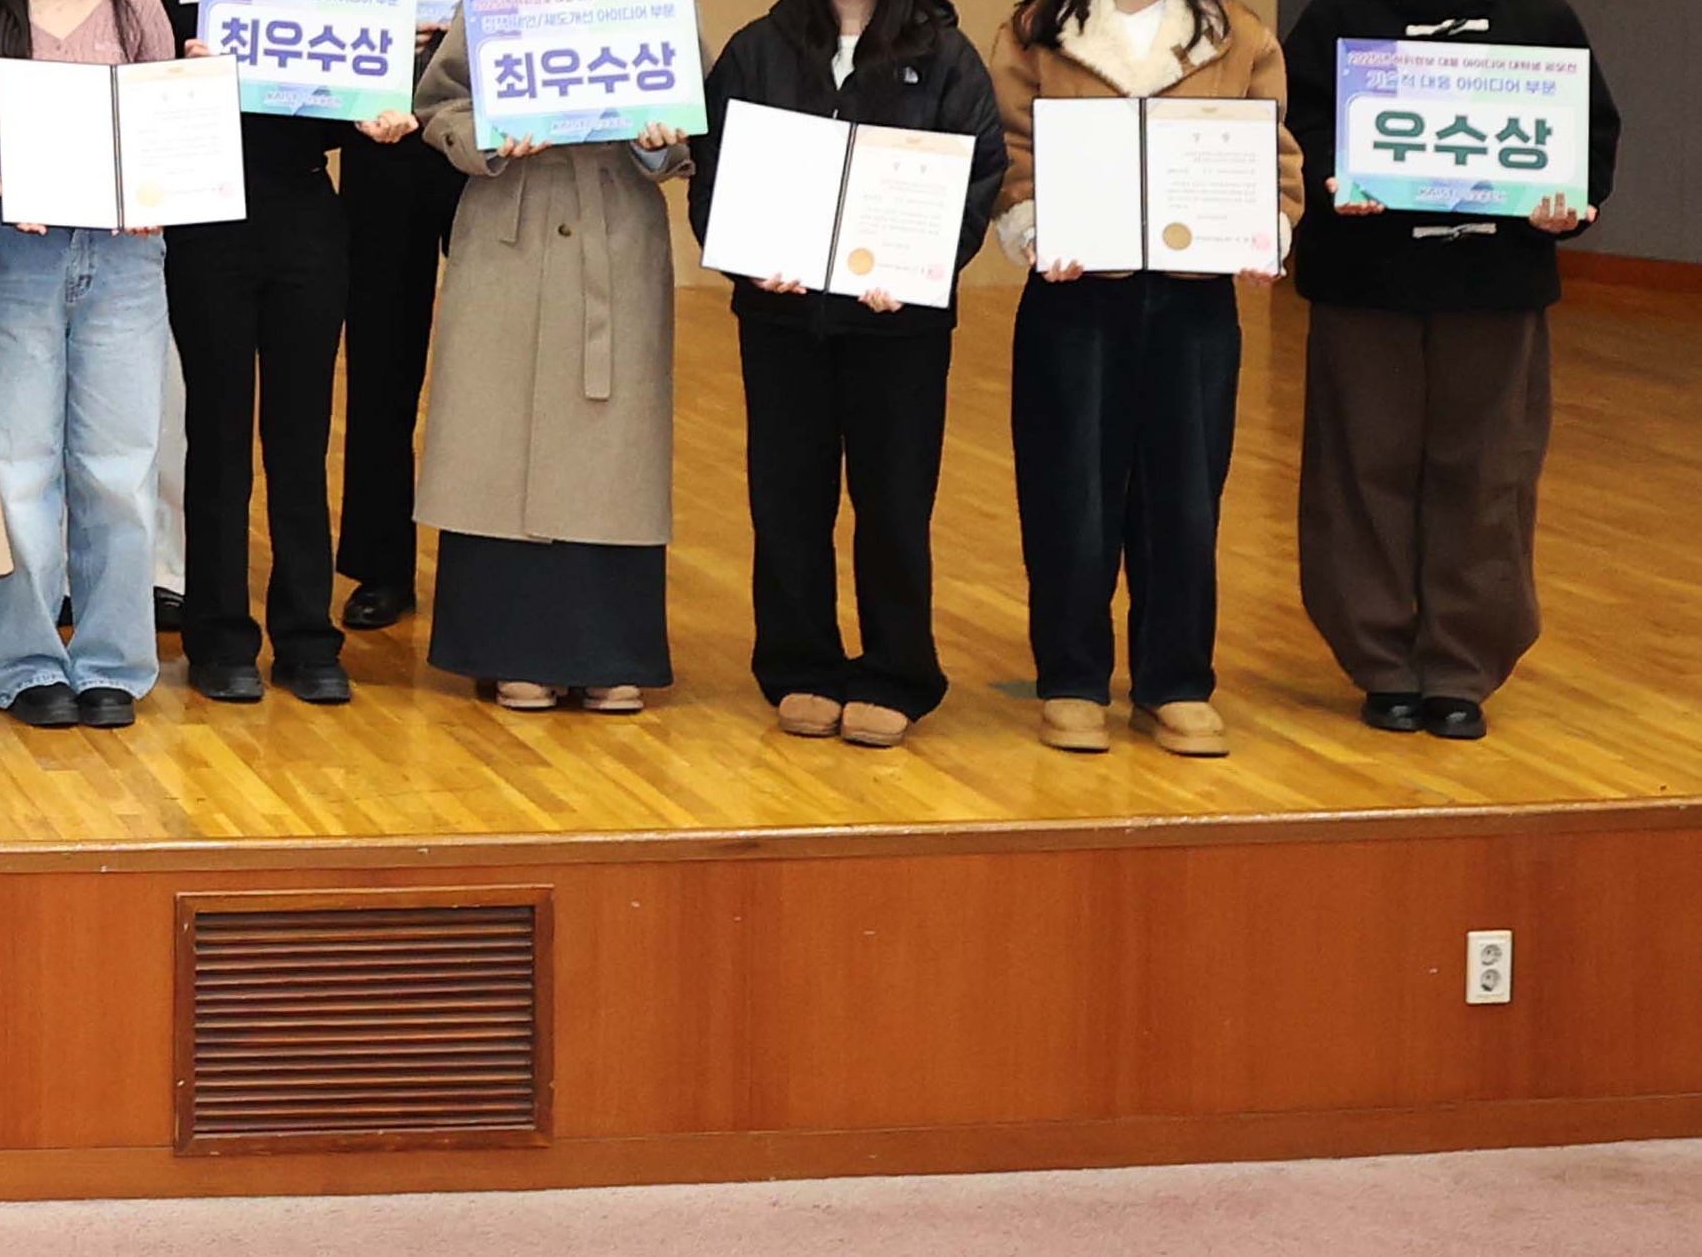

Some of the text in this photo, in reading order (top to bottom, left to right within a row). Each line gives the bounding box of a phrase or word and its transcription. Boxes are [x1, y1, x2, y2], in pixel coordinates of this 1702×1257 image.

[221, 18, 393, 76] 최우수상
[495, 42, 675, 98] 최우수상
[1373, 111, 1552, 169] 우수상
